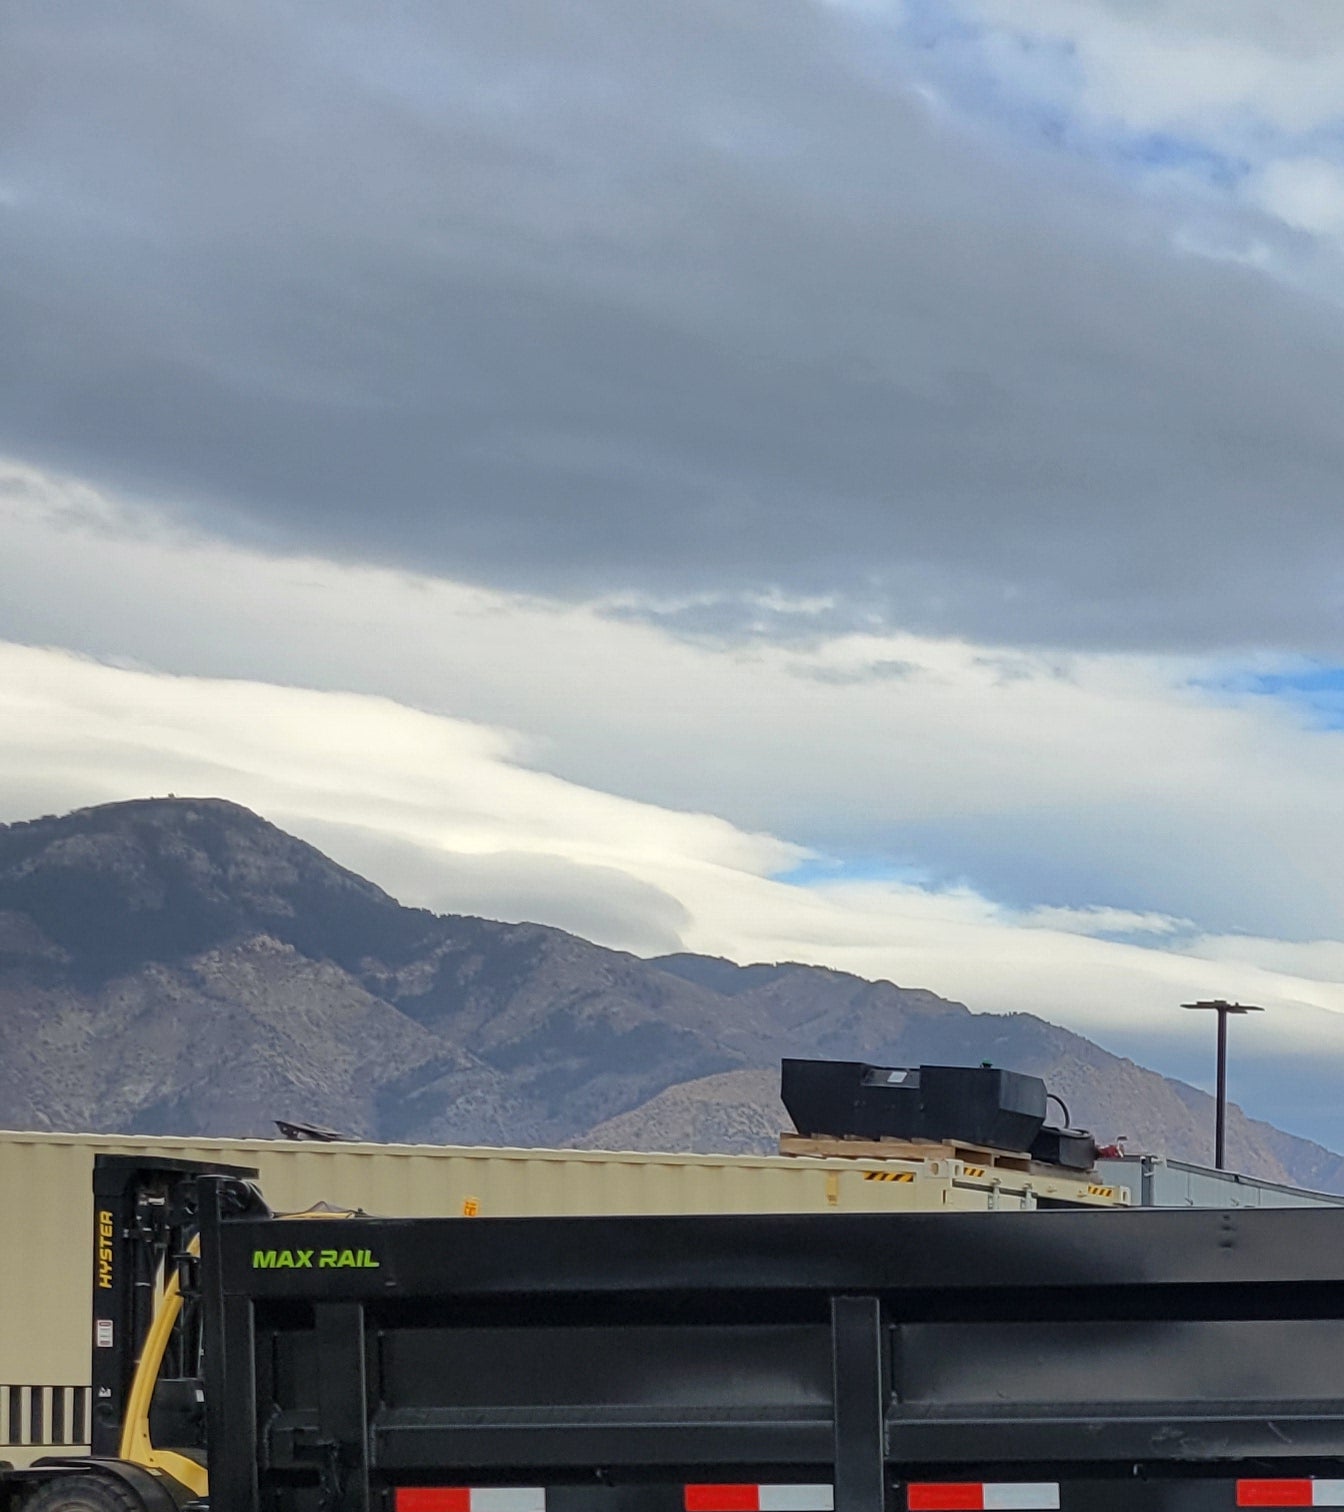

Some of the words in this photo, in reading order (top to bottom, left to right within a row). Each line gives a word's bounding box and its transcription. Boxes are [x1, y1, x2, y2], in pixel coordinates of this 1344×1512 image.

[99, 1210, 113, 1288] HYSTER
[252, 1250, 314, 1268] MAX
[318, 1249, 380, 1268] RAIL
